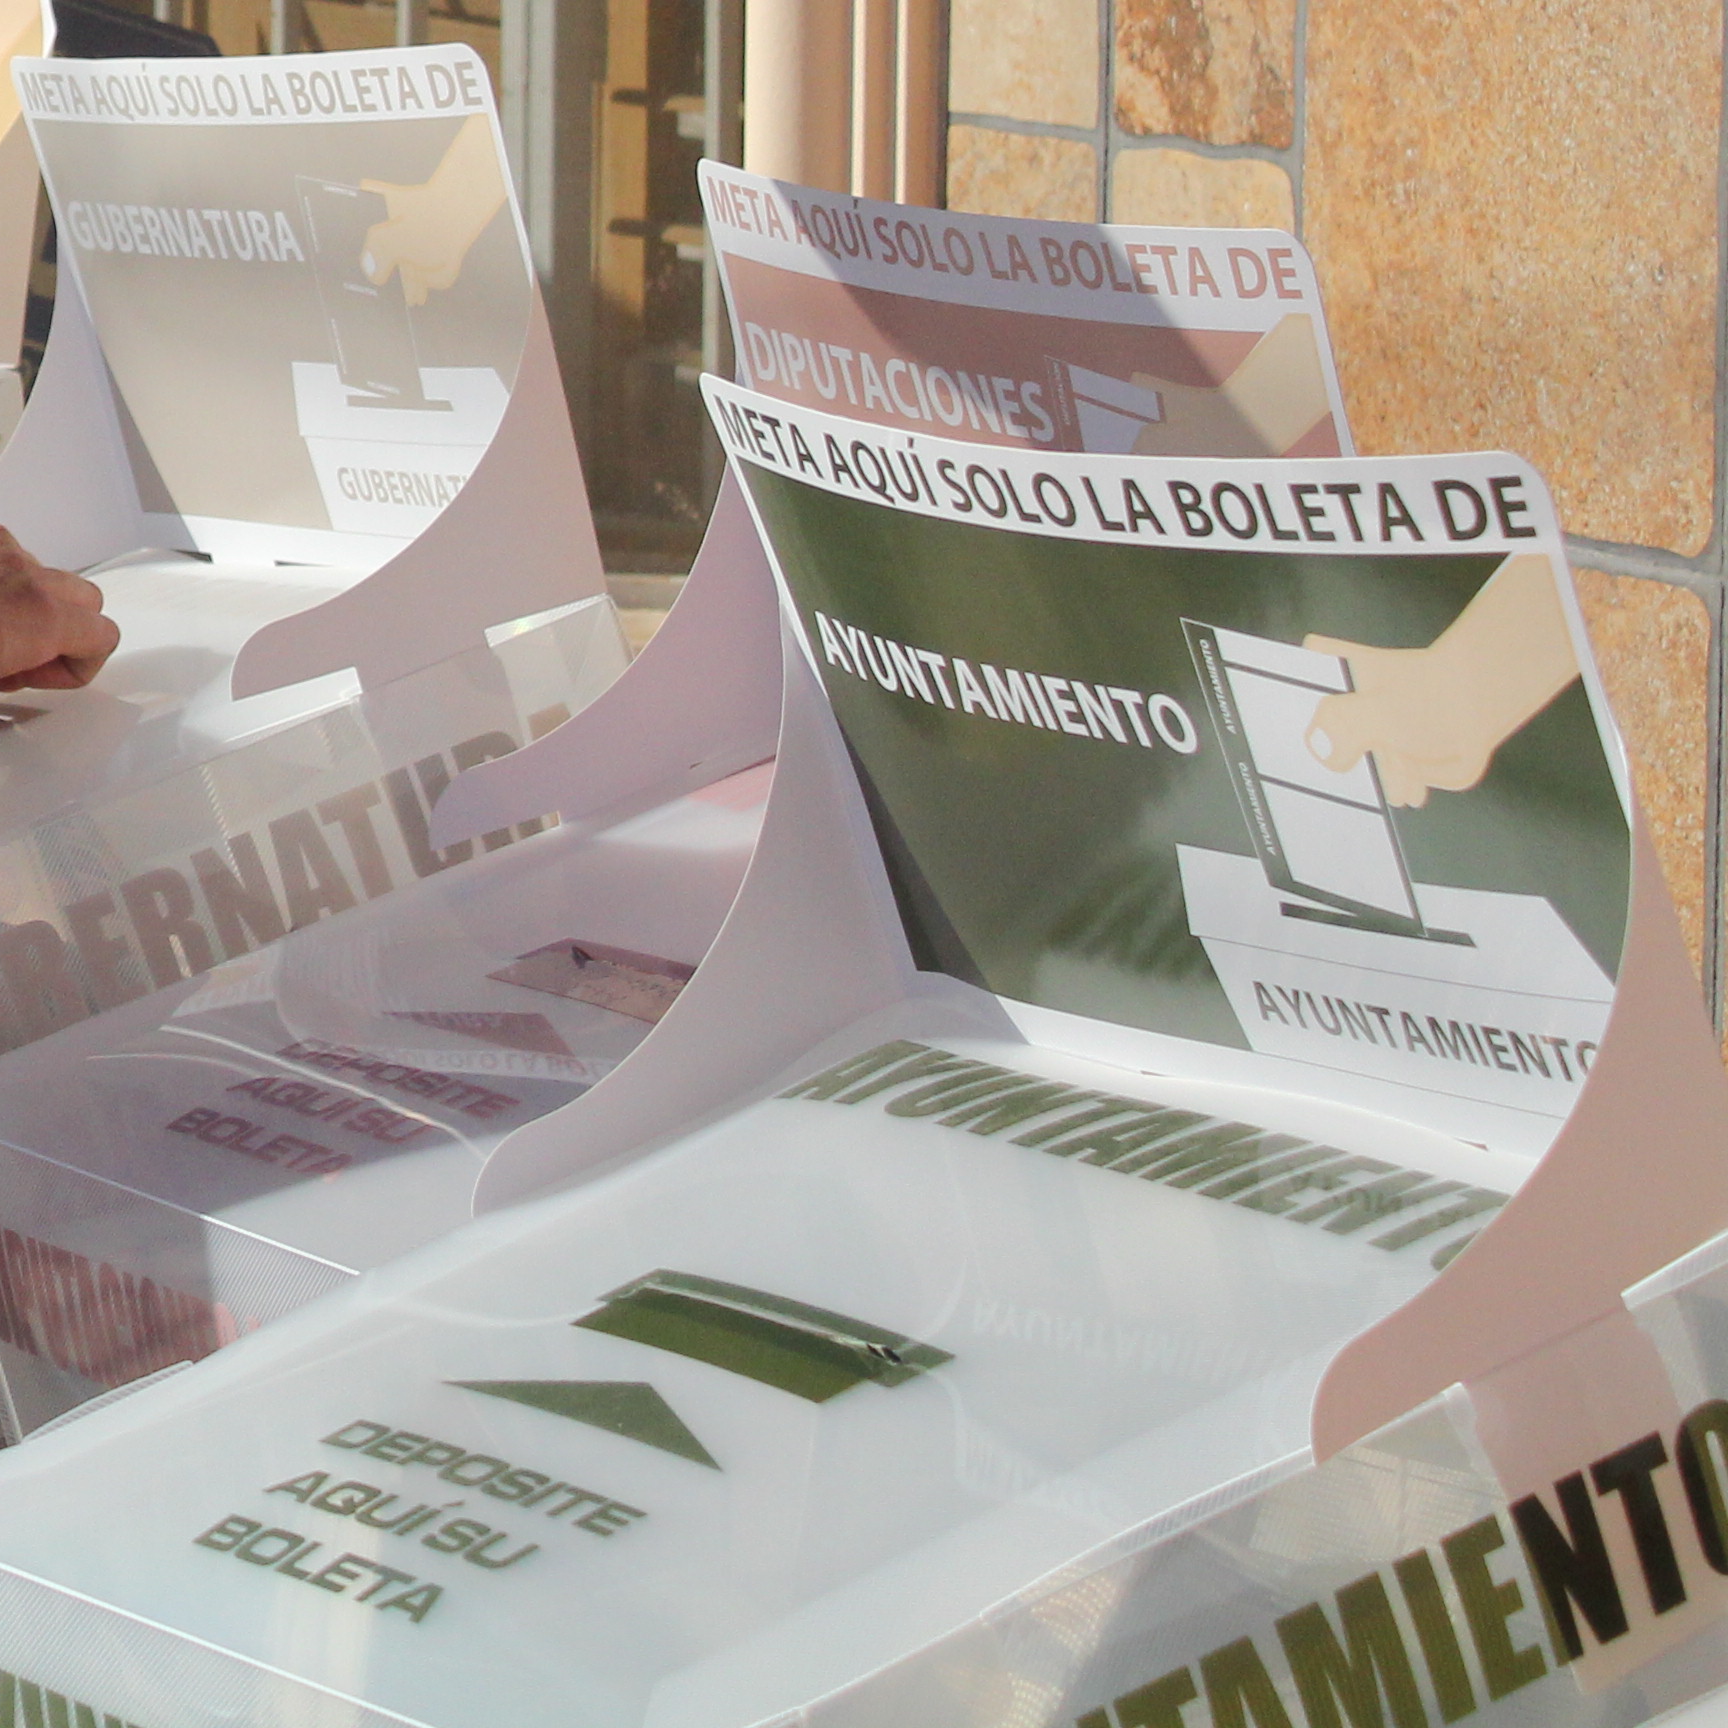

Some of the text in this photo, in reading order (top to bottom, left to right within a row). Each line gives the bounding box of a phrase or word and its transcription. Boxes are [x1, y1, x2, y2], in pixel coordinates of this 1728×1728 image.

[19, 60, 484, 121] META AQUÍ SOLO LA BOLETA DE
[67, 200, 305, 263] GUBERNATURA
[707, 174, 1304, 301] META AQUÍ SOLO LA BOLETA DE
[745, 322, 1056, 443] DIPUTACIONES
[337, 467, 467, 509] GUBERNAT
[713, 394, 1539, 544] META AQUÍ SOLO LA BOLETA DE
[815, 610, 1198, 755] AYUNTAMIENTO
[1199, 638, 1237, 735] AYUNTAMIENTO
[1238, 761, 1277, 856] AYUNTAMIENTO
[166, 1106, 352, 1182] BOLETA
[263, 1470, 540, 1570] AQUÍ SU
[319, 1419, 648, 1538] DEPOSITE
[192, 1513, 446, 1624] BOLETA
